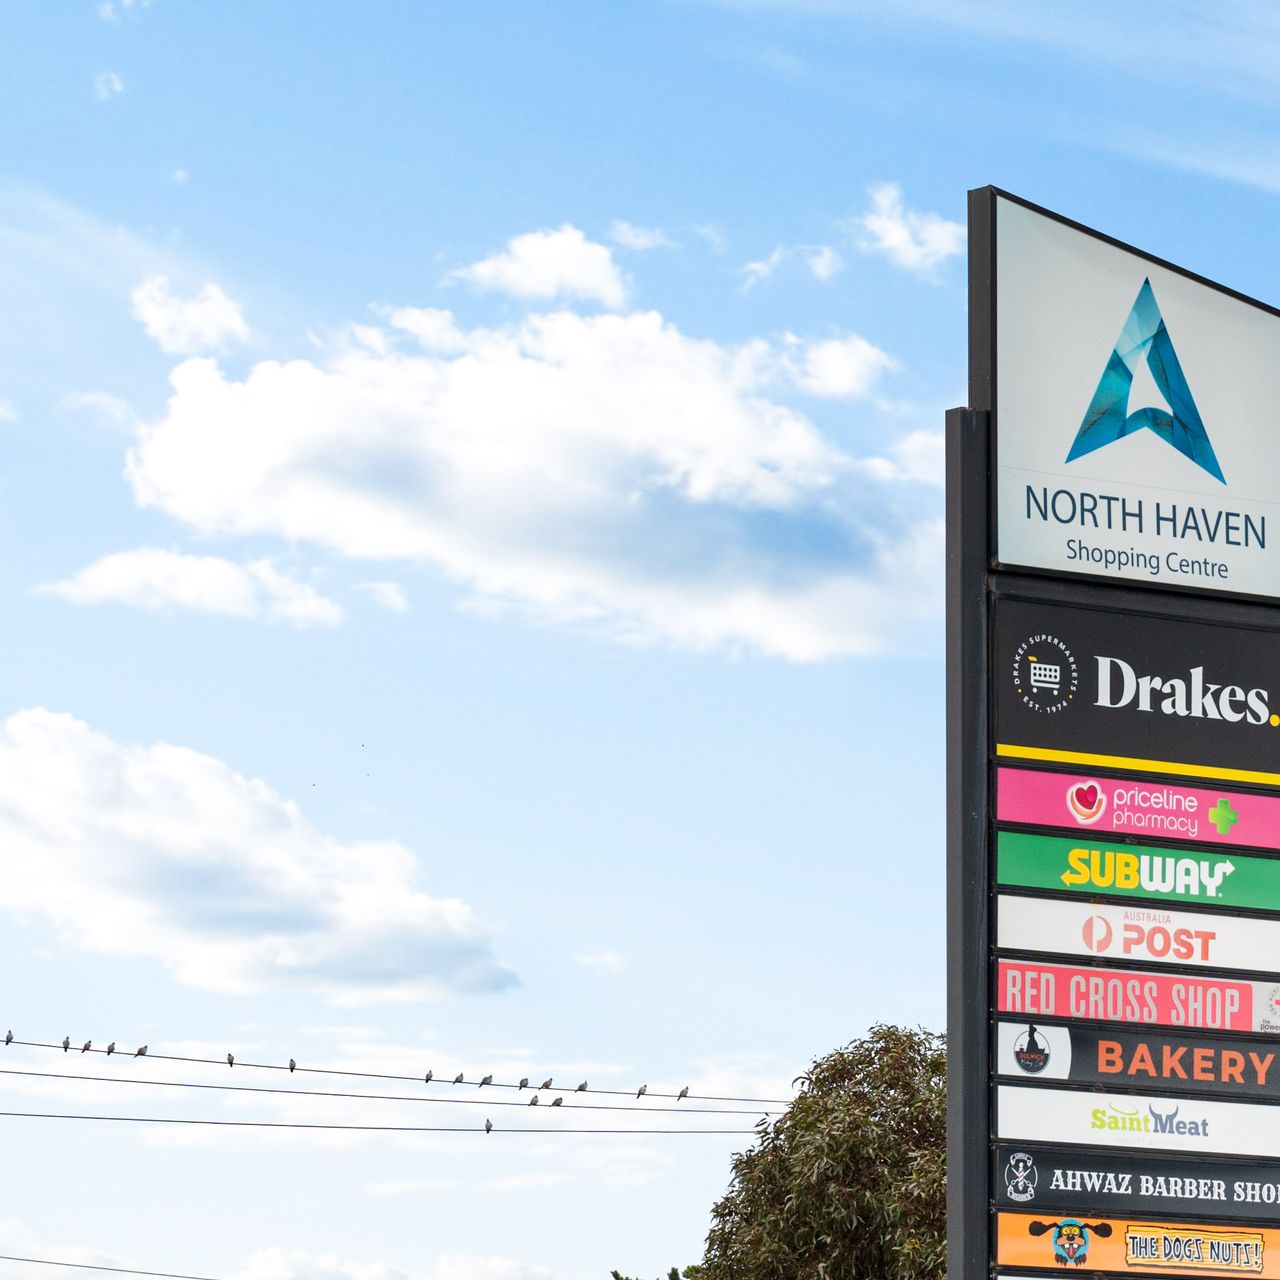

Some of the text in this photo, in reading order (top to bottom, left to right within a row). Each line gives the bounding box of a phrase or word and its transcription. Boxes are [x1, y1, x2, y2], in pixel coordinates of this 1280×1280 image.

[1026, 485, 1266, 549] NORTH HAVEN
[1066, 539, 1228, 578] Shopping Centre
[1013, 634, 1078, 692] DRAKES SUPERMARKETS
[1023, 696, 1067, 713] EST. 1974
[1113, 787, 1198, 812] priceline
[1113, 808, 1198, 837] pharmacy
[1060, 848, 1236, 897] SUBWAY
[1123, 911, 1172, 924] AUSTRALIA
[1123, 923, 1216, 961] POST
[1006, 969, 1056, 1015] RED
[1069, 975, 1158, 1023] CROSS
[1170, 983, 1240, 1030] SHOP
[1097, 1039, 1275, 1086] BAKERY
[1050, 1169, 1132, 1194] AHWAZ
[1139, 1175, 1227, 1200] BARBER
[1129, 1234, 1261, 1266] THE DOGS NUTS!
